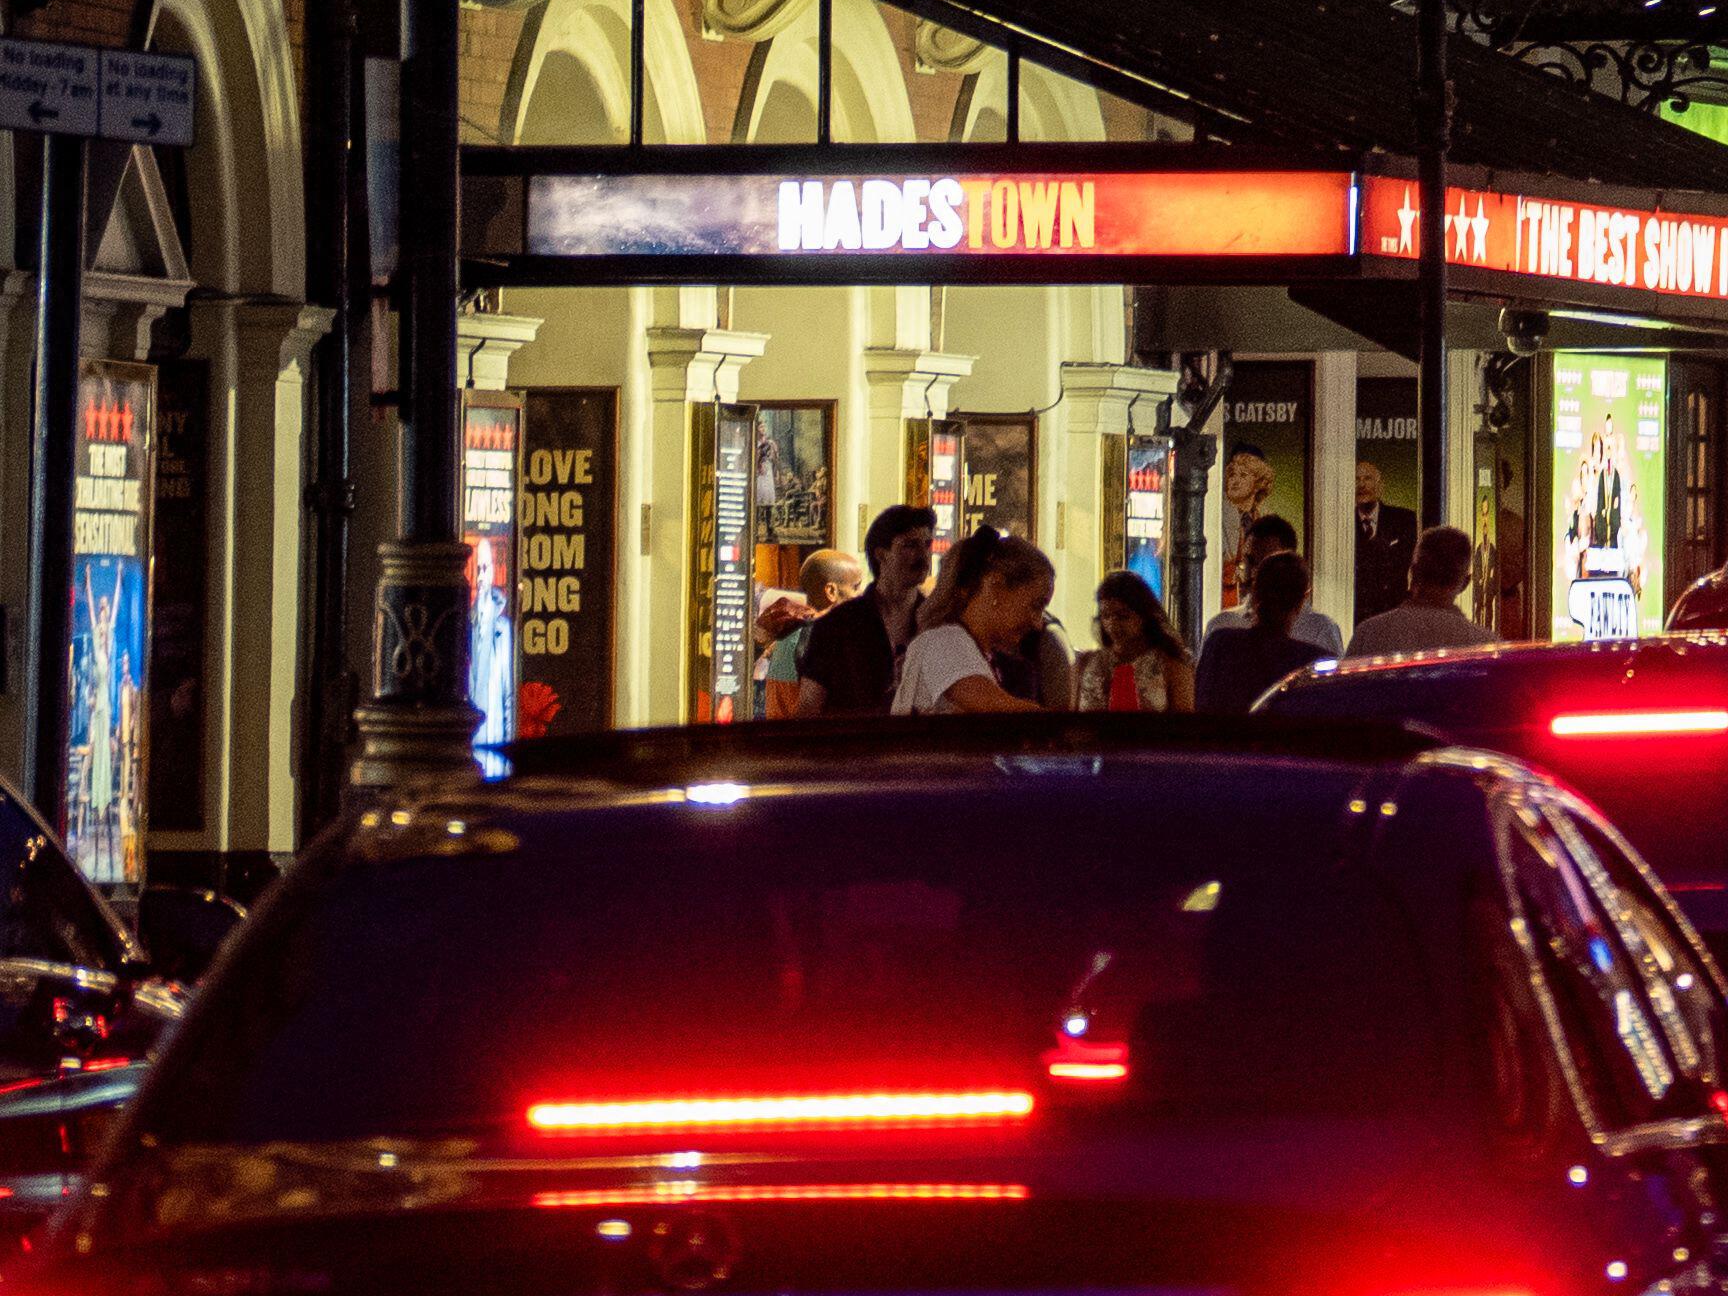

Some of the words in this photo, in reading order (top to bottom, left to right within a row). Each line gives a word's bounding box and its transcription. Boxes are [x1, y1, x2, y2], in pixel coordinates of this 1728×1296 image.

[108, 59, 129, 76] No
[134, 62, 188, 85] loading
[777, 178, 1095, 251] HADESTOWN
[1578, 208, 1640, 286] BEST
[1643, 217, 1715, 294] SHOW
[1235, 402, 1297, 423] GATSBY
[1356, 417, 1417, 439] MAJOR
[523, 618, 569, 655] GO
